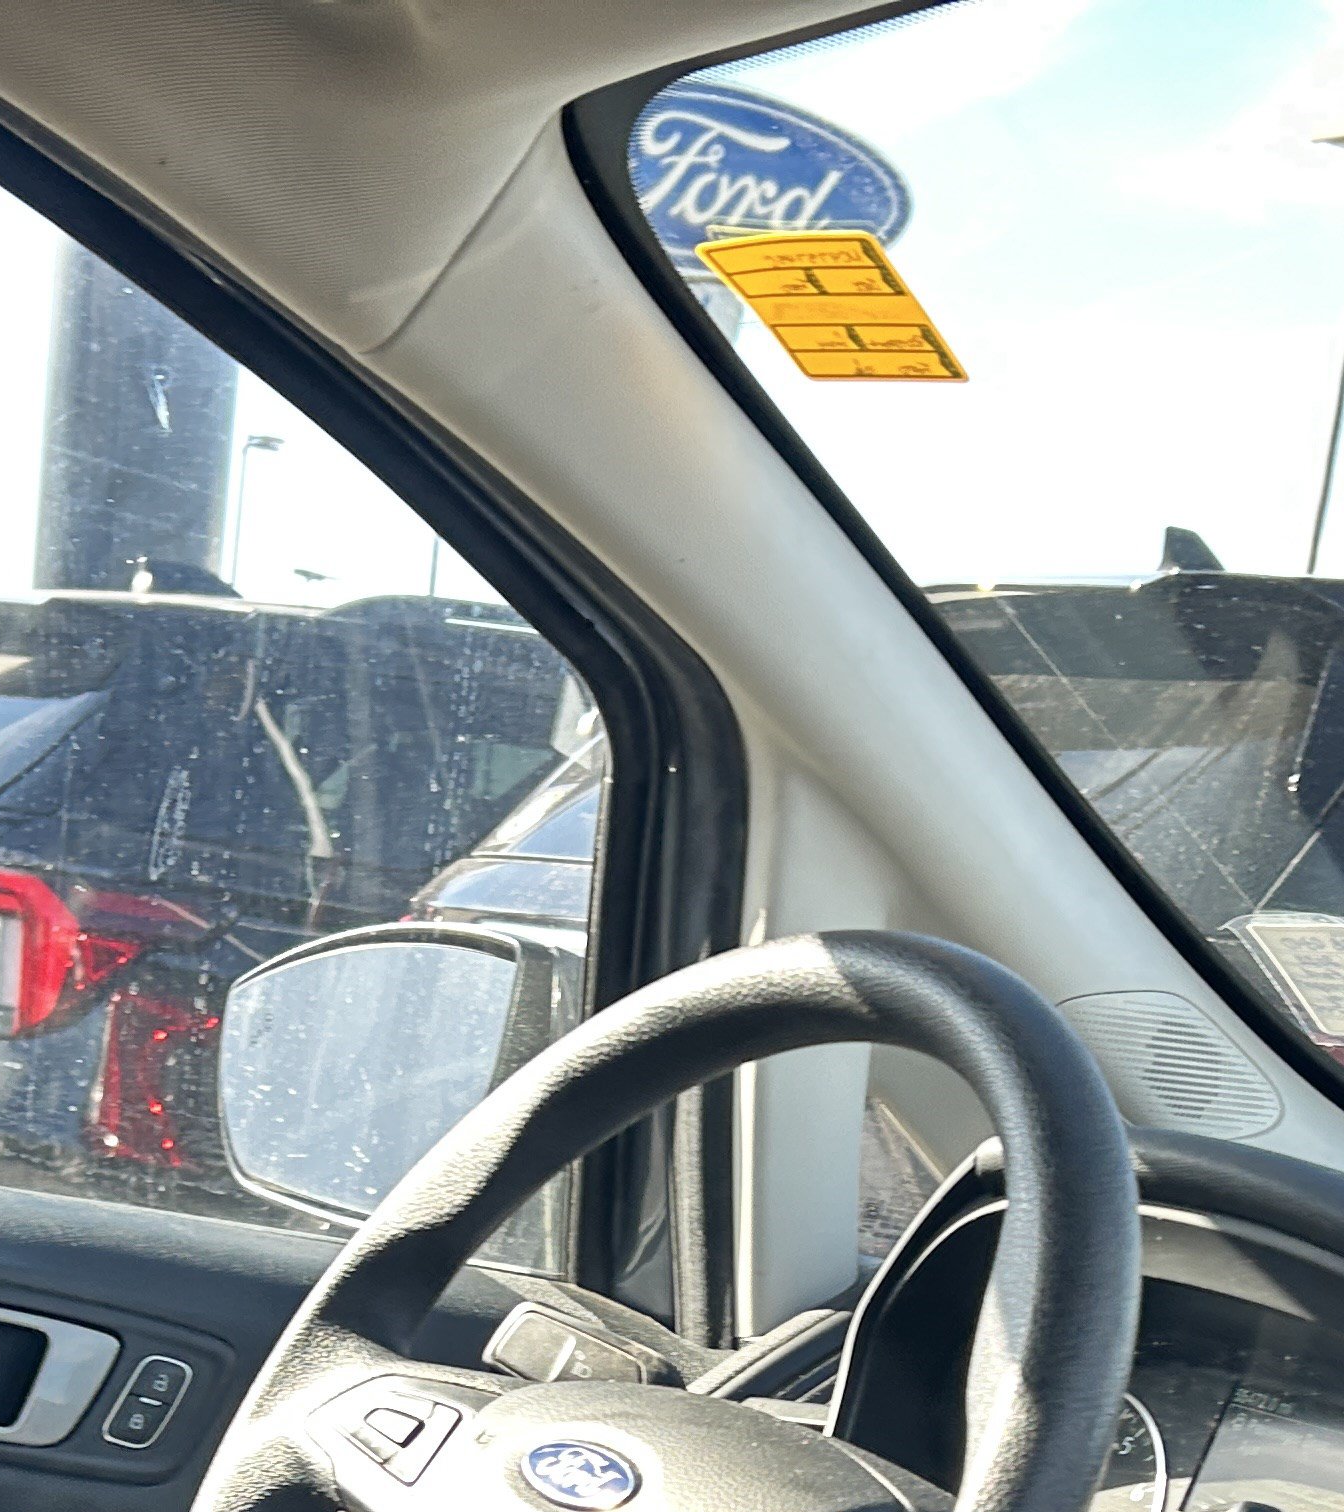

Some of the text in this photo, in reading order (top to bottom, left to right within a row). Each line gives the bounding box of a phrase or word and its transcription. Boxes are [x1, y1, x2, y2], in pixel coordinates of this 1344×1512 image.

[639, 109, 846, 232] Ford
[1118, 1435, 1136, 1456] 5
[535, 1446, 626, 1500] Ford
